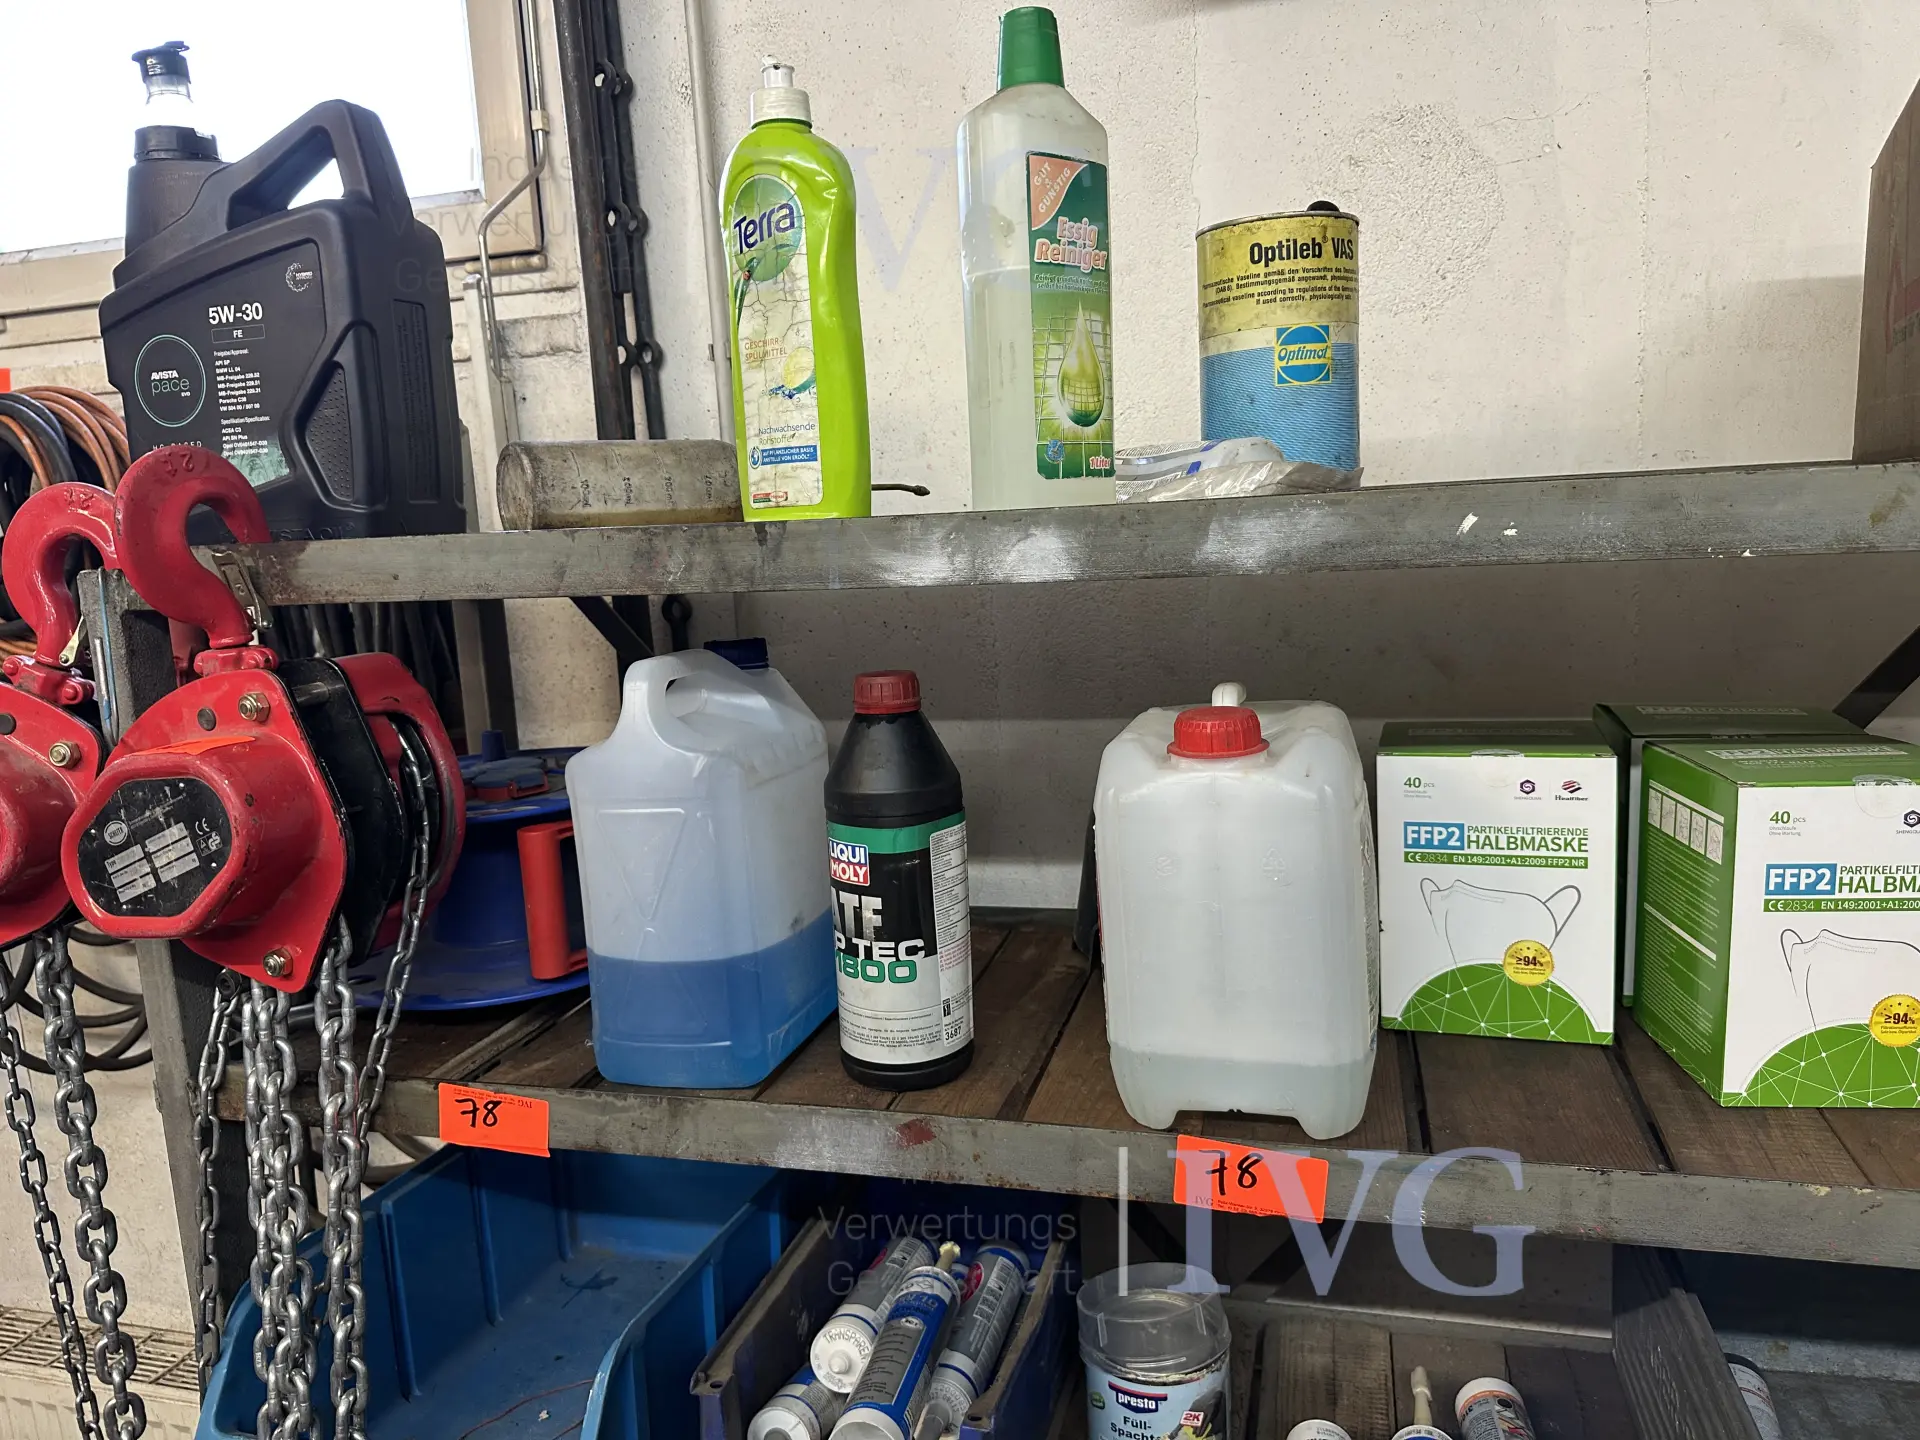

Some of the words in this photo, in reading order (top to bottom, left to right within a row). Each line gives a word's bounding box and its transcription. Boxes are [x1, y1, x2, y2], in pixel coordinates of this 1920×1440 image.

[1034, 161, 1052, 186] GUT
[734, 203, 795, 255] Terra
[1057, 216, 1098, 251] Essig
[1034, 238, 1107, 273] Reiniger
[1331, 237, 1354, 260] VAS
[1236, 271, 1260, 283] Vaseline
[1287, 267, 1299, 275] den
[1236, 275, 1296, 290] Bestimmungsgemäß
[1257, 287, 1287, 298] according
[1296, 284, 1327, 294] regulations
[1262, 297, 1278, 305] used
[209, 302, 263, 325] 5W-30
[233, 329, 243, 339] FE
[745, 347, 787, 361] SPÜLMITTEL
[1277, 346, 1329, 364] Optimol
[151, 370, 179, 381] AVISTA
[151, 378, 190, 397] pace
[759, 423, 815, 435] Nachwachsende
[760, 433, 791, 446] Rohstoffe
[1096, 456, 1111, 470] Liter
[1403, 777, 1421, 789] 40
[1423, 782, 1435, 792] pcs
[1769, 811, 1790, 824] 40
[1792, 815, 1807, 825] pcs
[1406, 825, 1462, 847] FFP2
[1467, 825, 1589, 838] PARTIKELFILTRIERENDE
[830, 840, 866, 863] LIQUI
[1466, 834, 1589, 853] HALBMASKE
[1421, 853, 1448, 864] 2834
[1453, 855, 1464, 864] EN
[1467, 855, 1536, 867] 149:2001+A1:2009
[1538, 857, 1560, 868] FFP2
[1562, 858, 1576, 868] NR
[831, 861, 868, 883] MOLY
[1768, 867, 1833, 892] FFP2
[1786, 899, 1816, 912] 2834
[1820, 900, 1835, 911] EN
[852, 936, 926, 964] TEC
[838, 951, 918, 984] 1800
[944, 1027, 963, 1042] 3687
[454, 1097, 503, 1128] 78
[1198, 1149, 1264, 1196] 78
[1117, 1391, 1157, 1411] presto
[1122, 1415, 1152, 1430] Füll-
[1182, 1411, 1202, 1423] 2K
